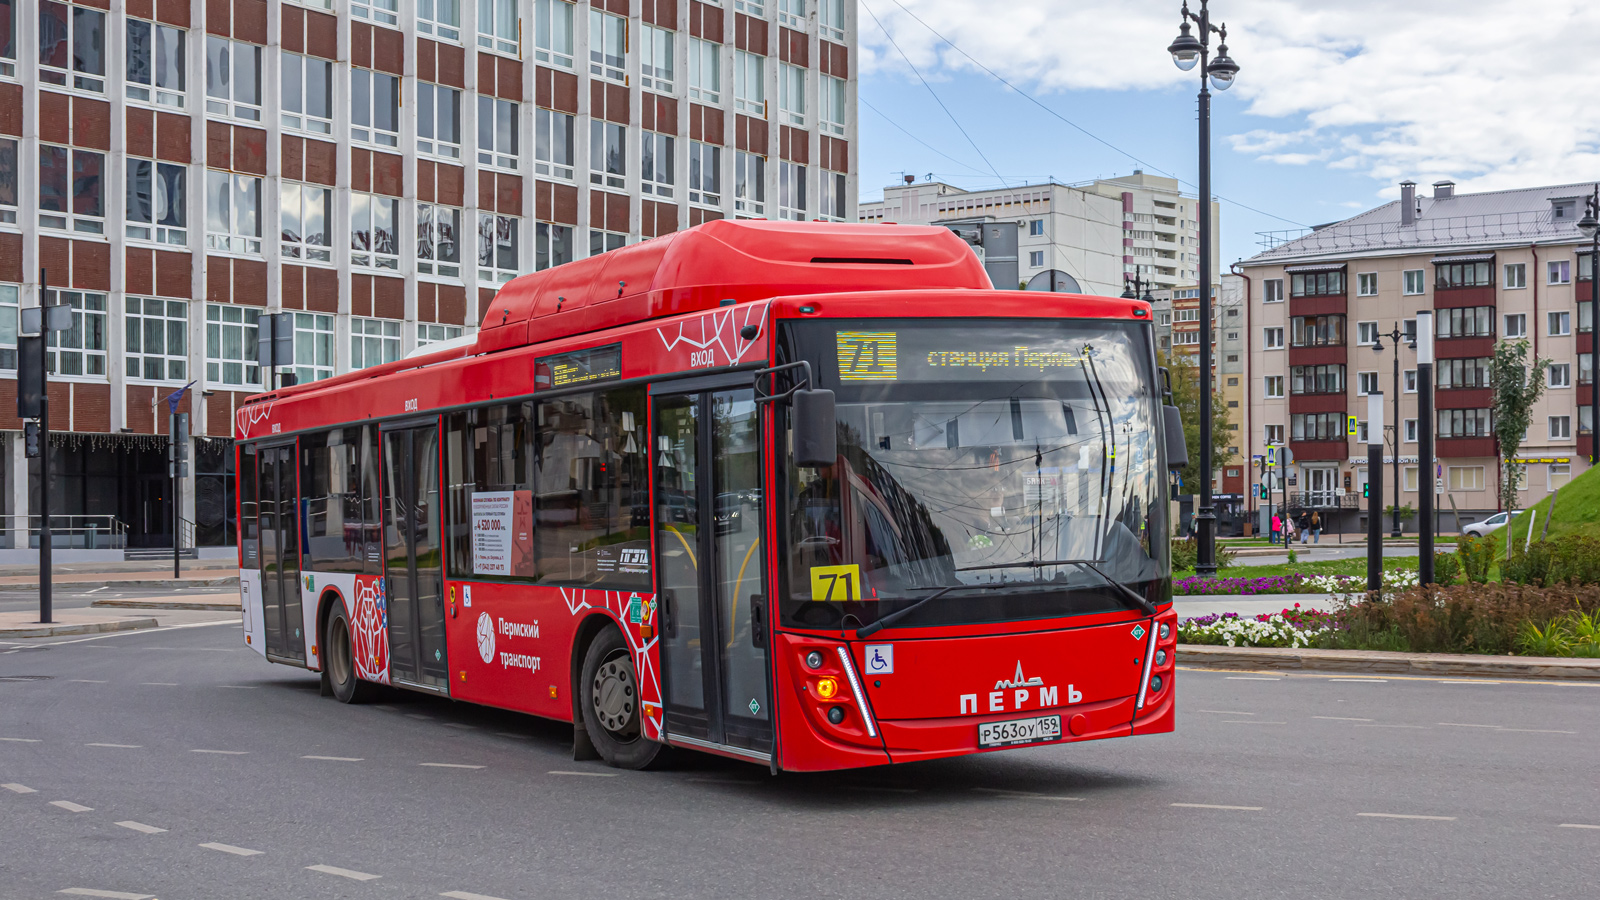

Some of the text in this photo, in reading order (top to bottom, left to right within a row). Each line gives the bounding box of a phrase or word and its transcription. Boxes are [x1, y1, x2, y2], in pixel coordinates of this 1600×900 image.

[690, 348, 715, 369] ВХОД
[927, 351, 1009, 372] станция
[404, 398, 418, 412] ВХОД
[477, 519, 481, 530] 4
[481, 519, 490, 531] 520
[491, 519, 501, 531] 000
[818, 572, 854, 601] 71
[498, 617, 540, 640] Пермский
[500, 651, 541, 674] транспорт
[960, 684, 1083, 714] ПЕРМЬ
[984, 717, 1057, 742] Р563ОУ 159
